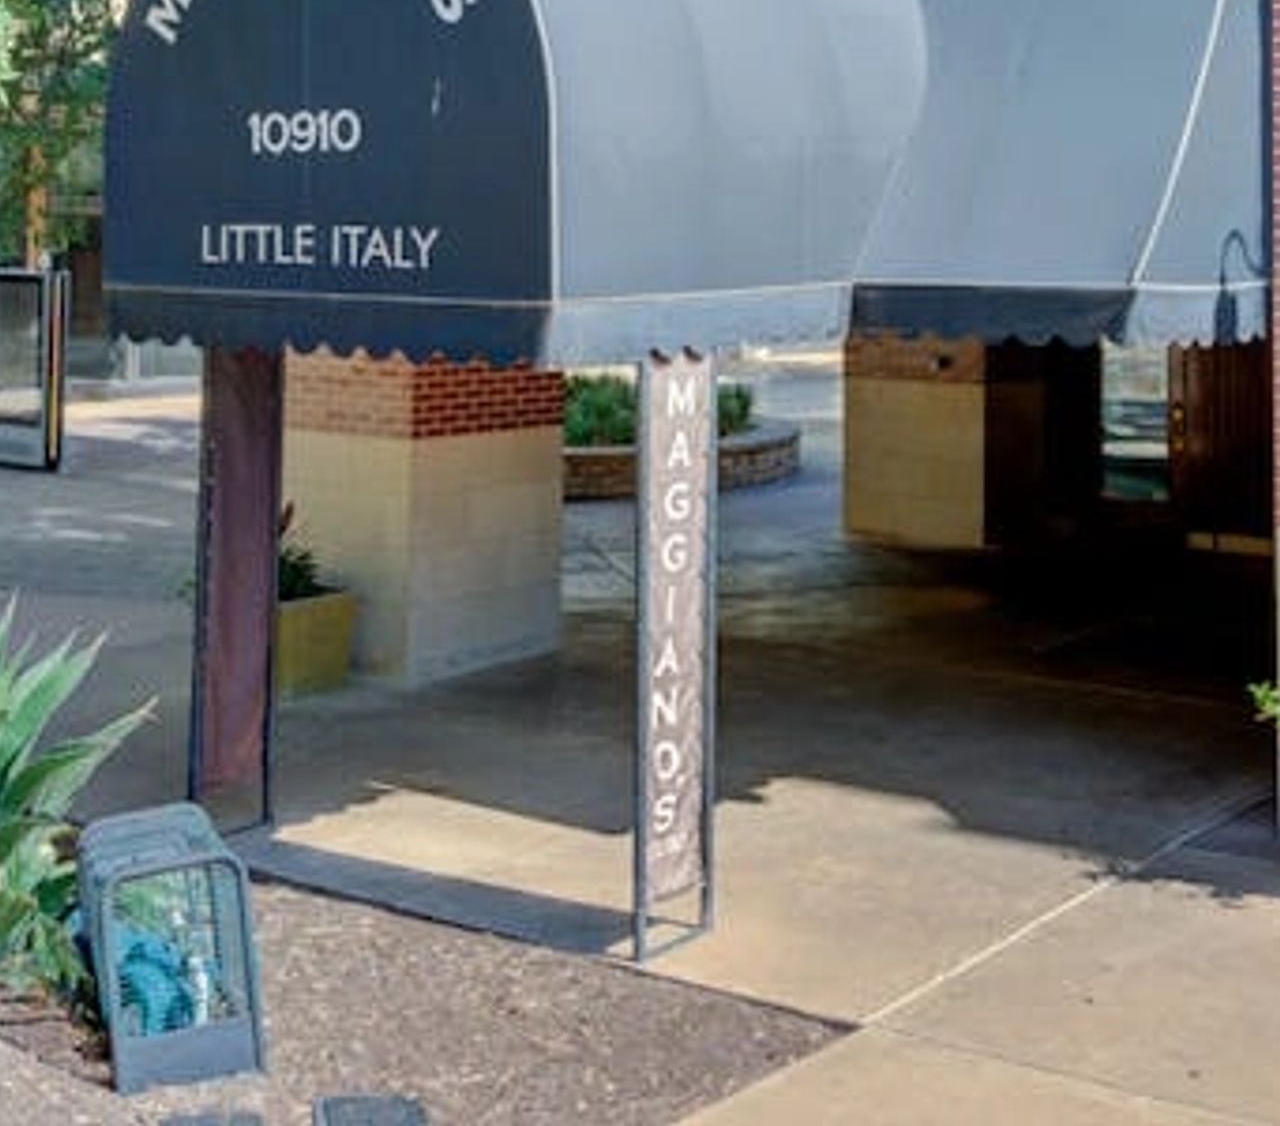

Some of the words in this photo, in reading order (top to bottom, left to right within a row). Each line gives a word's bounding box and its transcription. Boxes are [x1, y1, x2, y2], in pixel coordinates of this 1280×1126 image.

[247, 108, 363, 155] 10910
[201, 225, 317, 265] LITTLE
[331, 226, 440, 270] ITALY
